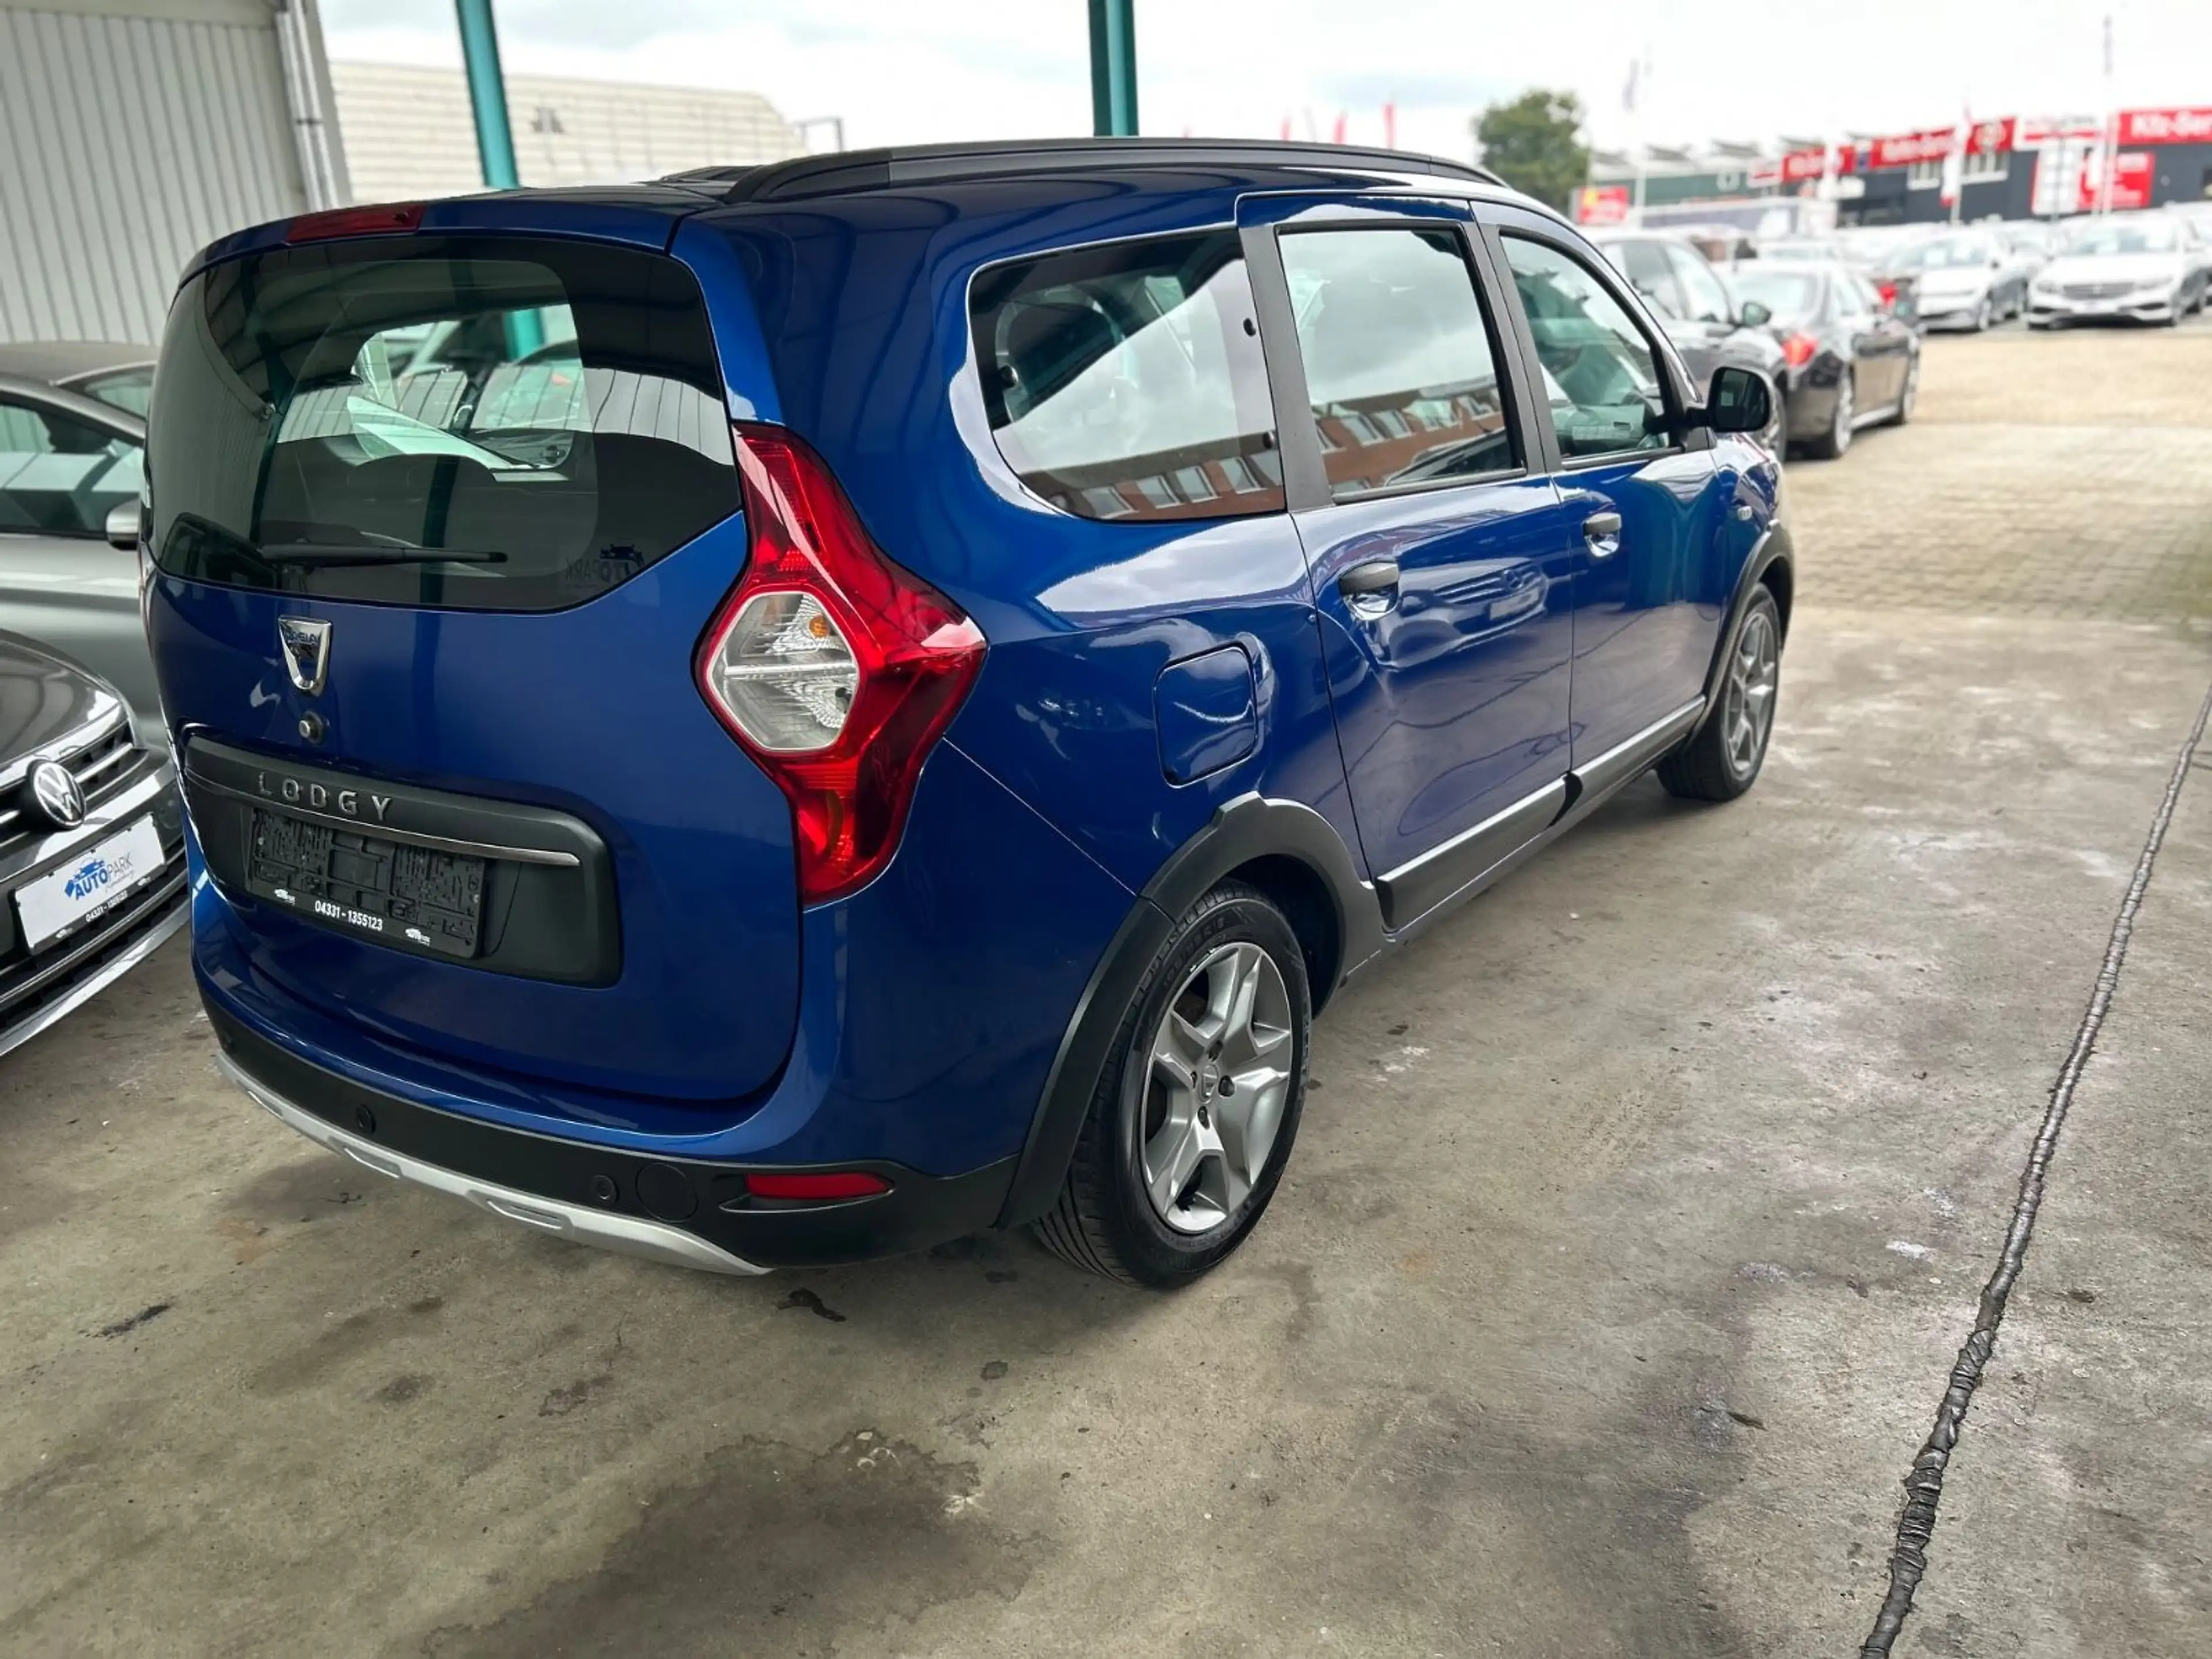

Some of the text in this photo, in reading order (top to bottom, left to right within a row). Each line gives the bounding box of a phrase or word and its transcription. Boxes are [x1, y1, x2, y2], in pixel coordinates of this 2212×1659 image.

[258, 771, 392, 820] LODGY
[315, 900, 341, 919] 04331
[347, 909, 383, 932] 1355123
